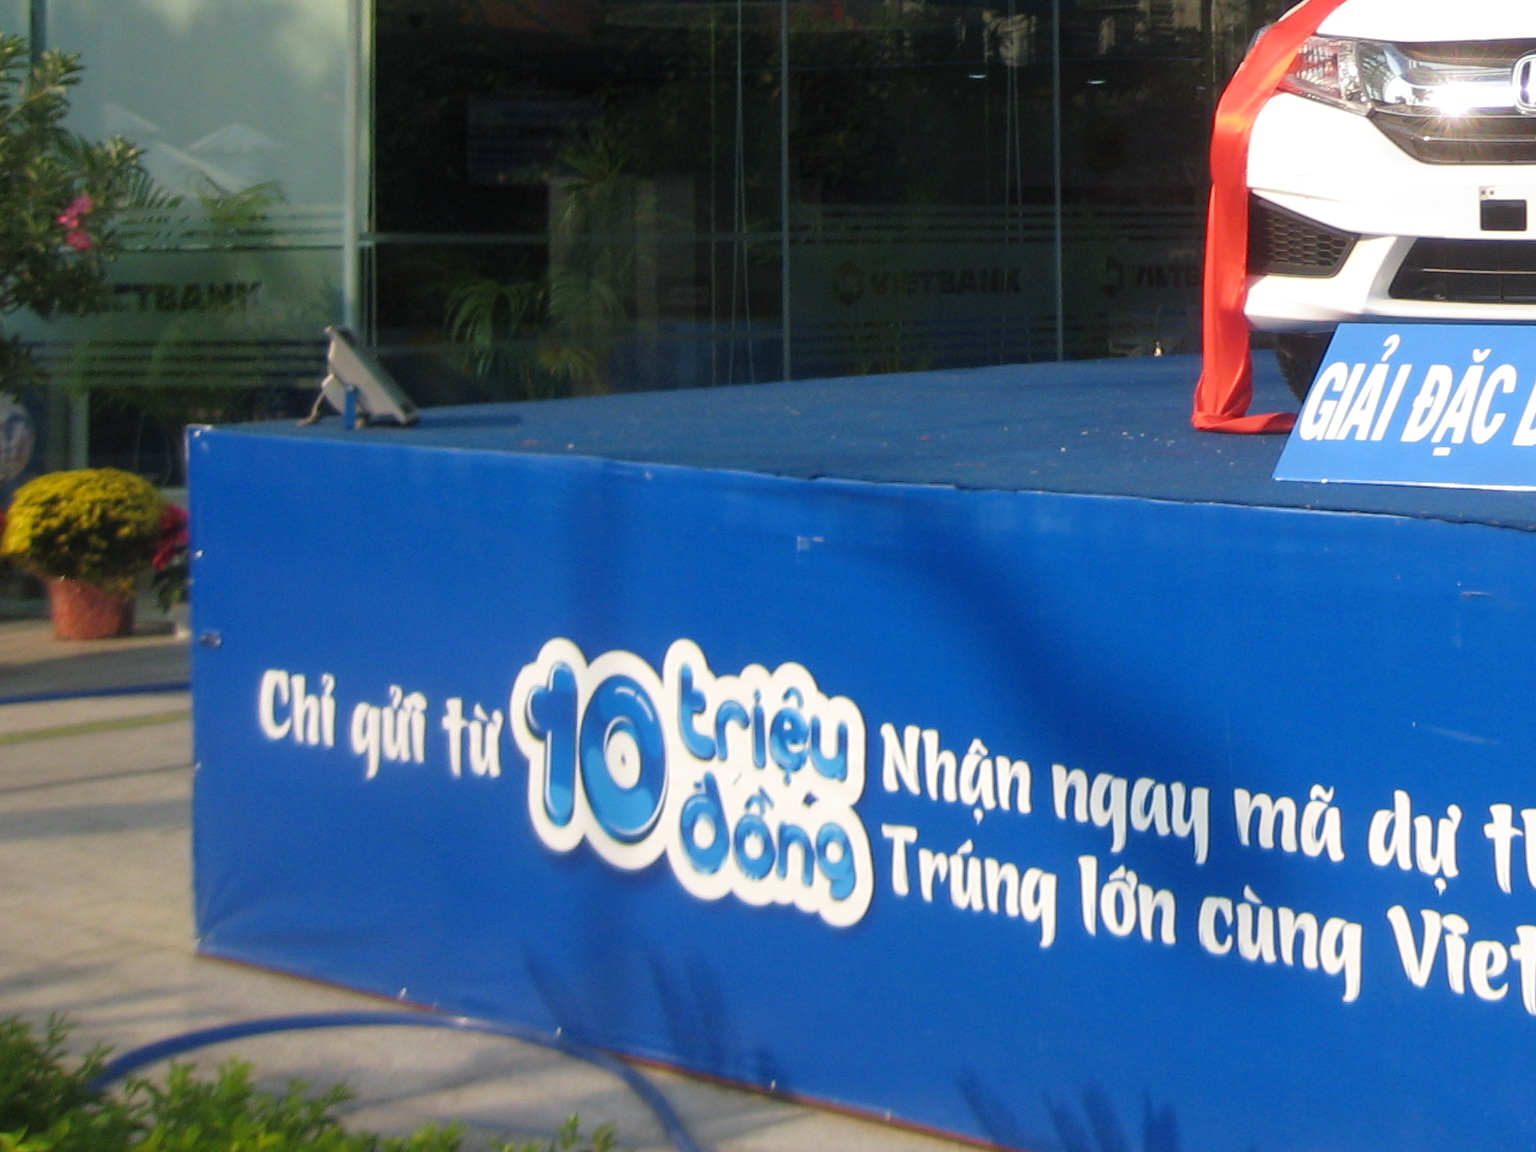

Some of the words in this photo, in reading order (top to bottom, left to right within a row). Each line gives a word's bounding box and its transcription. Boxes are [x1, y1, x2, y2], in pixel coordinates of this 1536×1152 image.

[1300, 334, 1413, 441] GIẢI
[1401, 348, 1518, 456] ĐẶC
[258, 669, 336, 747] Chỉ
[350, 685, 427, 780] gửi
[441, 696, 504, 779] từ
[677, 662, 850, 783] triệu
[880, 722, 1032, 826] Nhận
[1050, 760, 1210, 865] ngay
[1233, 783, 1345, 863] mã
[1367, 789, 1464, 896] dự
[880, 822, 1058, 949] Trúng
[1077, 854, 1177, 946] lớn
[1198, 885, 1362, 1005] cùng
